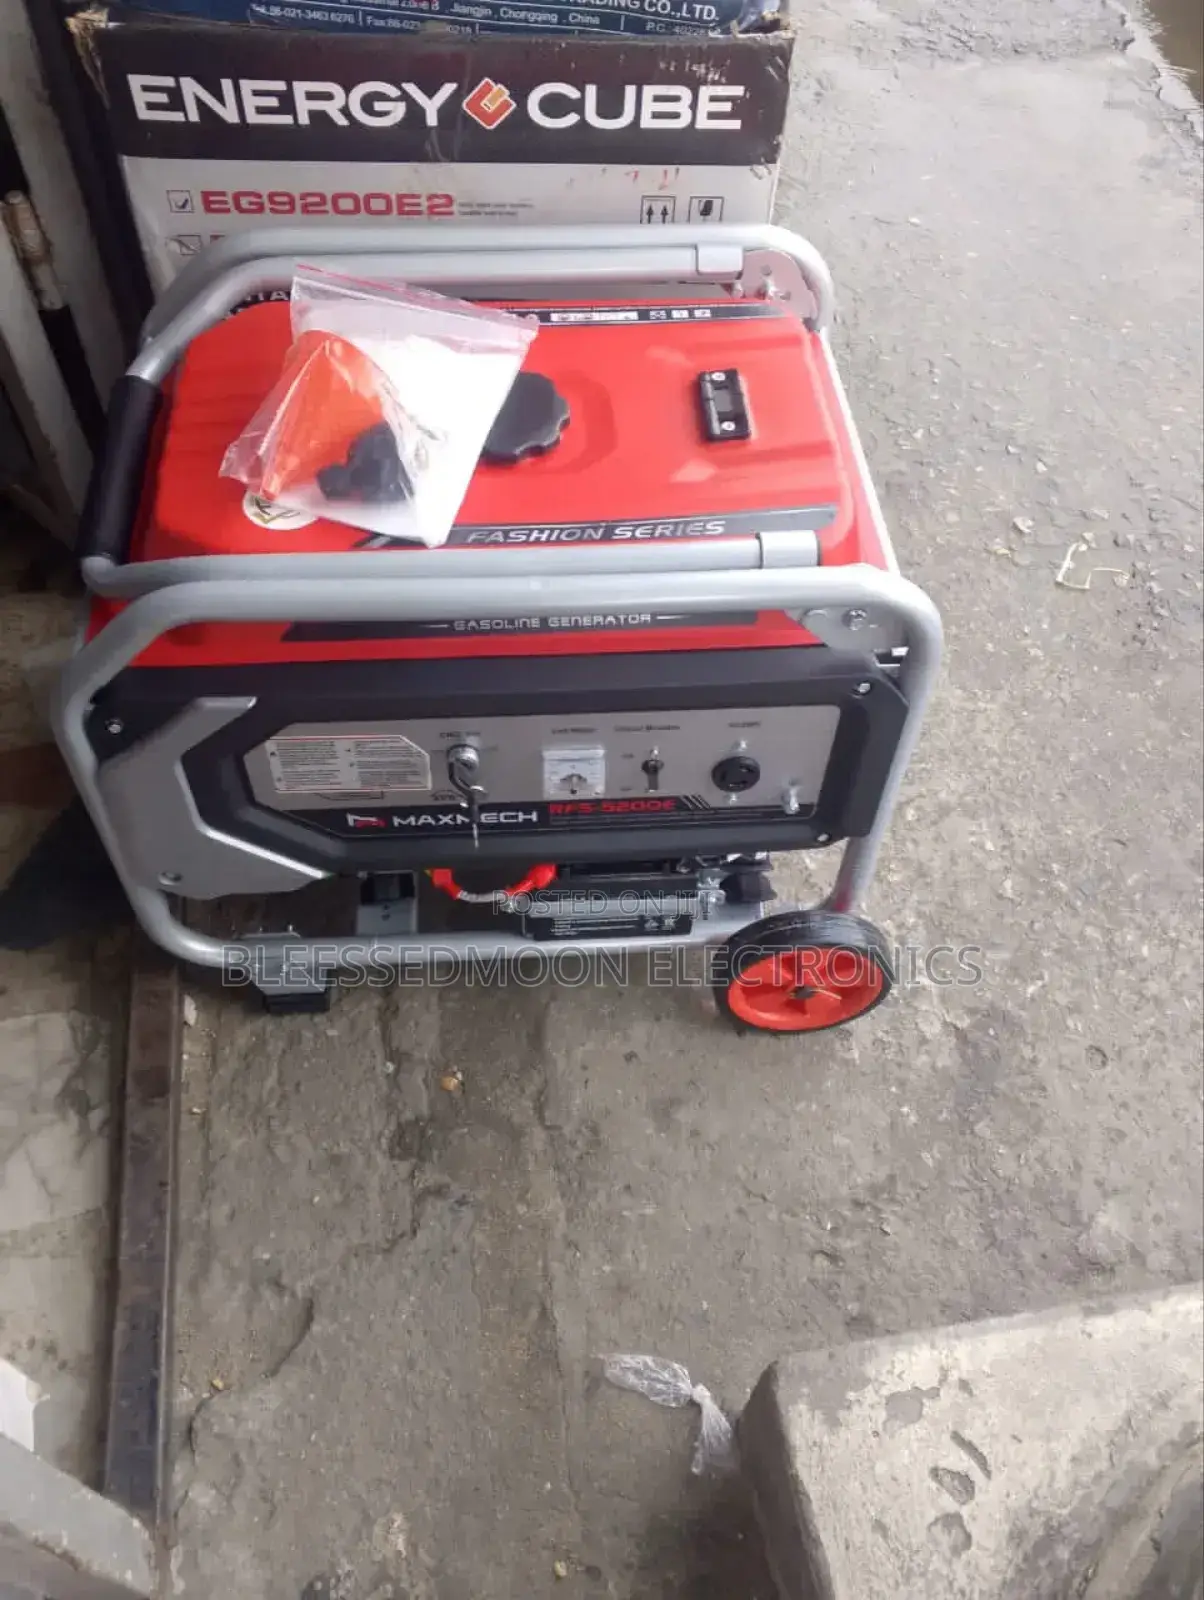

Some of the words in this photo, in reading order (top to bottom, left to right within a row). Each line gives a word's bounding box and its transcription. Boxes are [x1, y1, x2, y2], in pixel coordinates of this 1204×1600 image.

[126, 73, 458, 127] ENERGY
[526, 82, 746, 130] CUBE
[201, 190, 455, 217] EG9200E2
[467, 525, 604, 544] FASHION
[612, 520, 725, 540] SERIES
[453, 617, 541, 632] GASOLINE
[548, 613, 652, 629] GENERATOR
